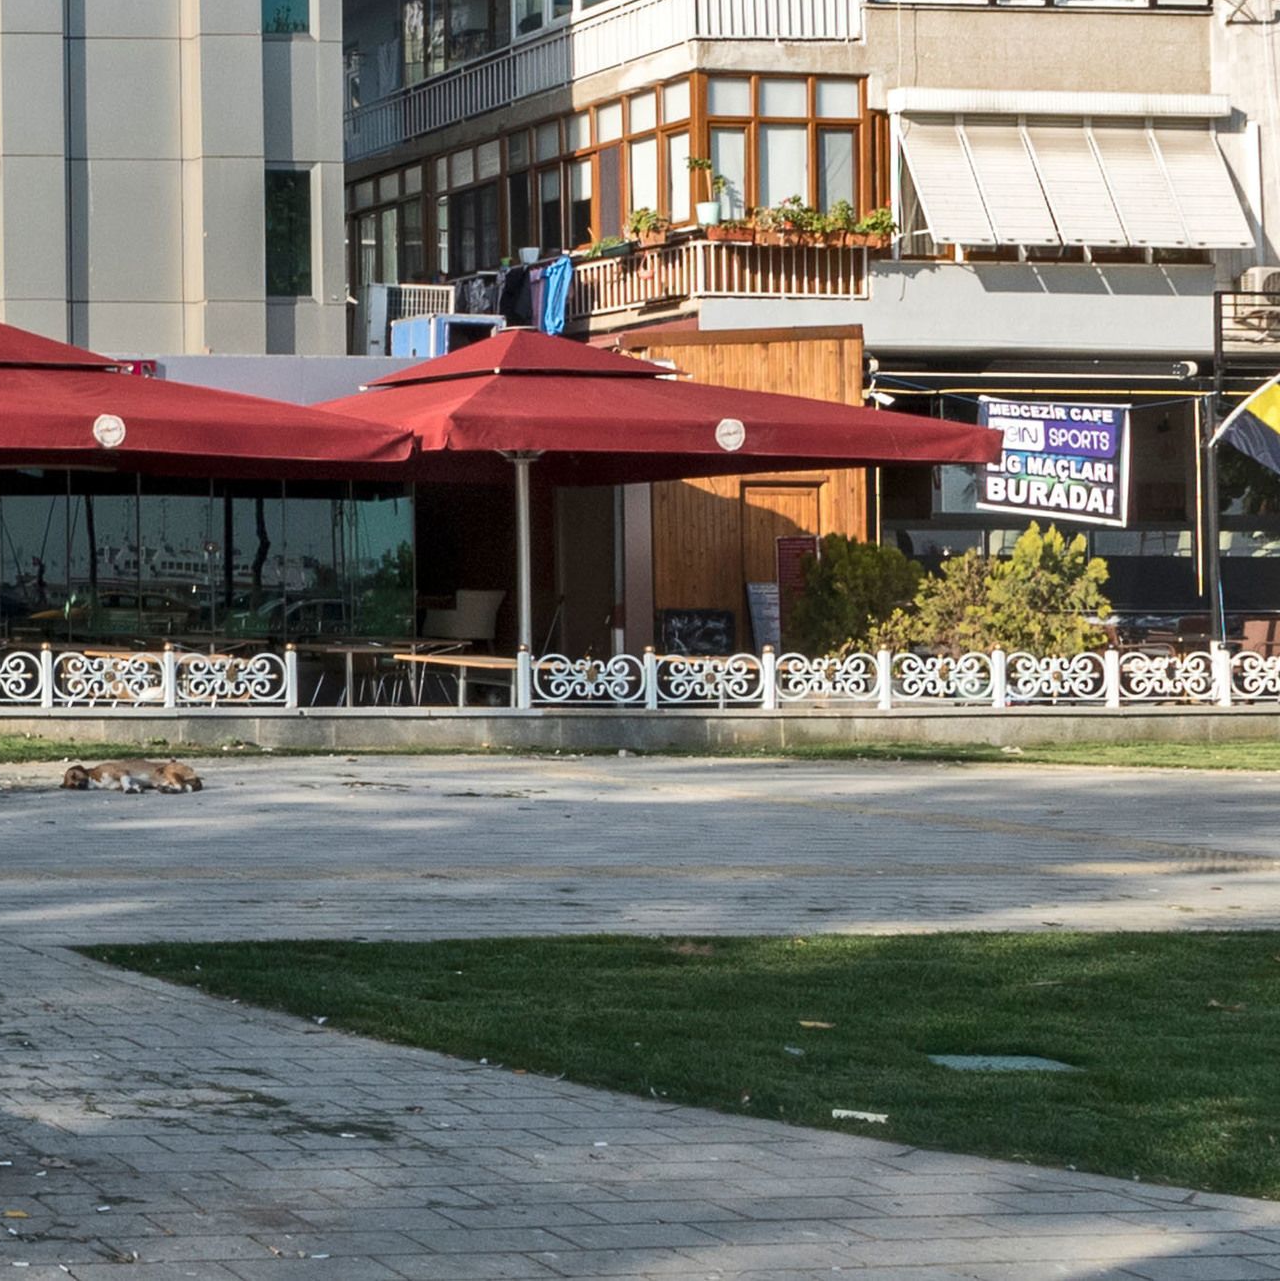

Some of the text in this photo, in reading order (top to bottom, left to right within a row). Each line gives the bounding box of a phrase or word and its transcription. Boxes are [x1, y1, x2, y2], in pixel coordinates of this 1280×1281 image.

[988, 403, 1114, 423] MEDCEZİR CAFE
[1048, 427, 1110, 451] SPORTS
[1027, 456, 1114, 483] MAÇLARI
[986, 476, 1115, 514] BURADA!
